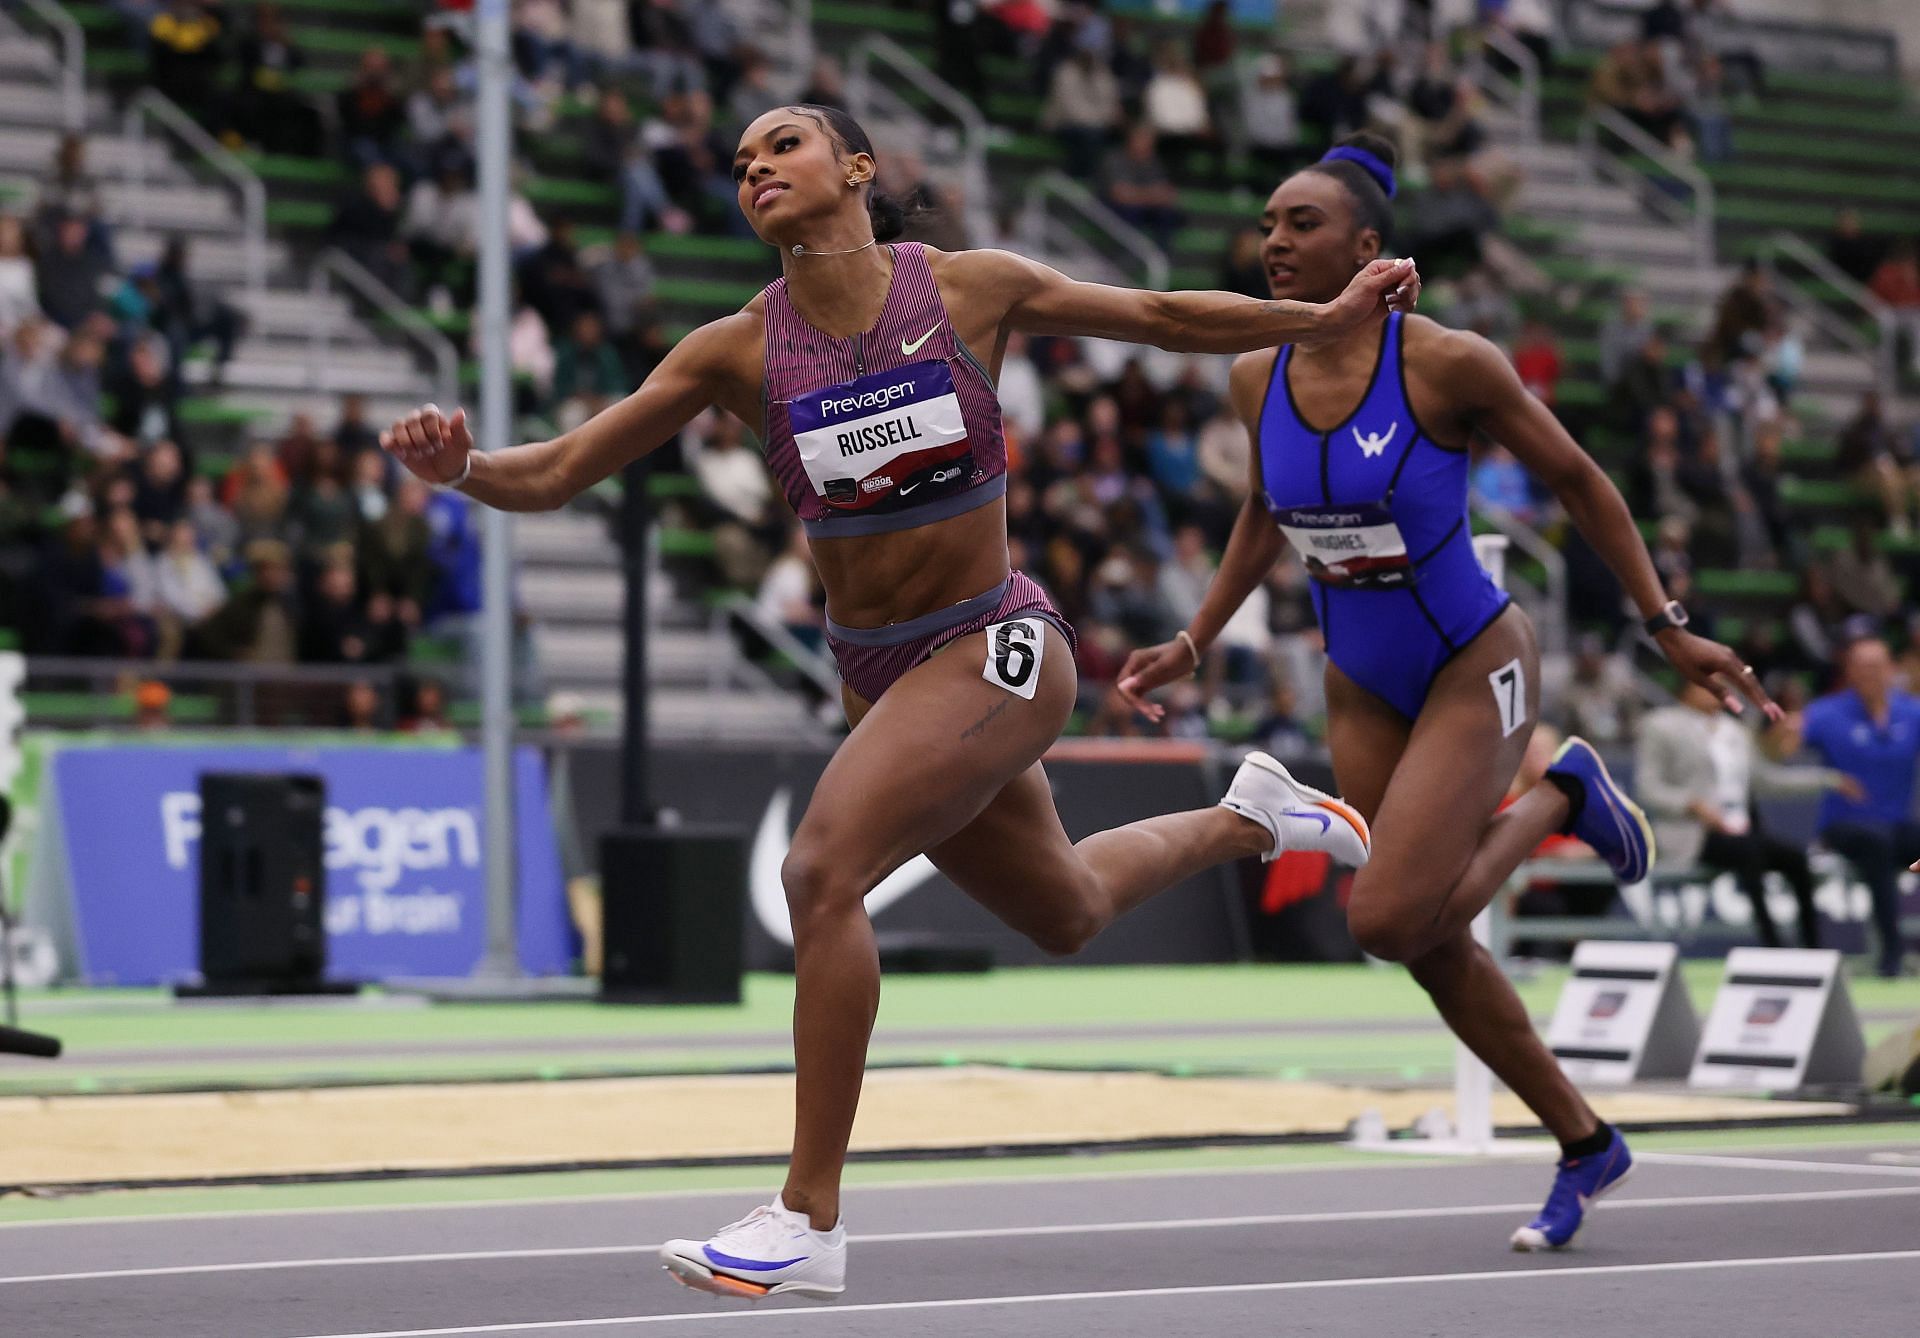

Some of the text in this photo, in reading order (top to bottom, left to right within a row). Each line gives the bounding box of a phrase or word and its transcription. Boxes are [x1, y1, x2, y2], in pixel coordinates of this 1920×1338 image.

[821, 381, 916, 418] Prevagen
[837, 416, 922, 457] RUSSELL
[995, 621, 1036, 687] 6
[1499, 668, 1516, 728] 7
